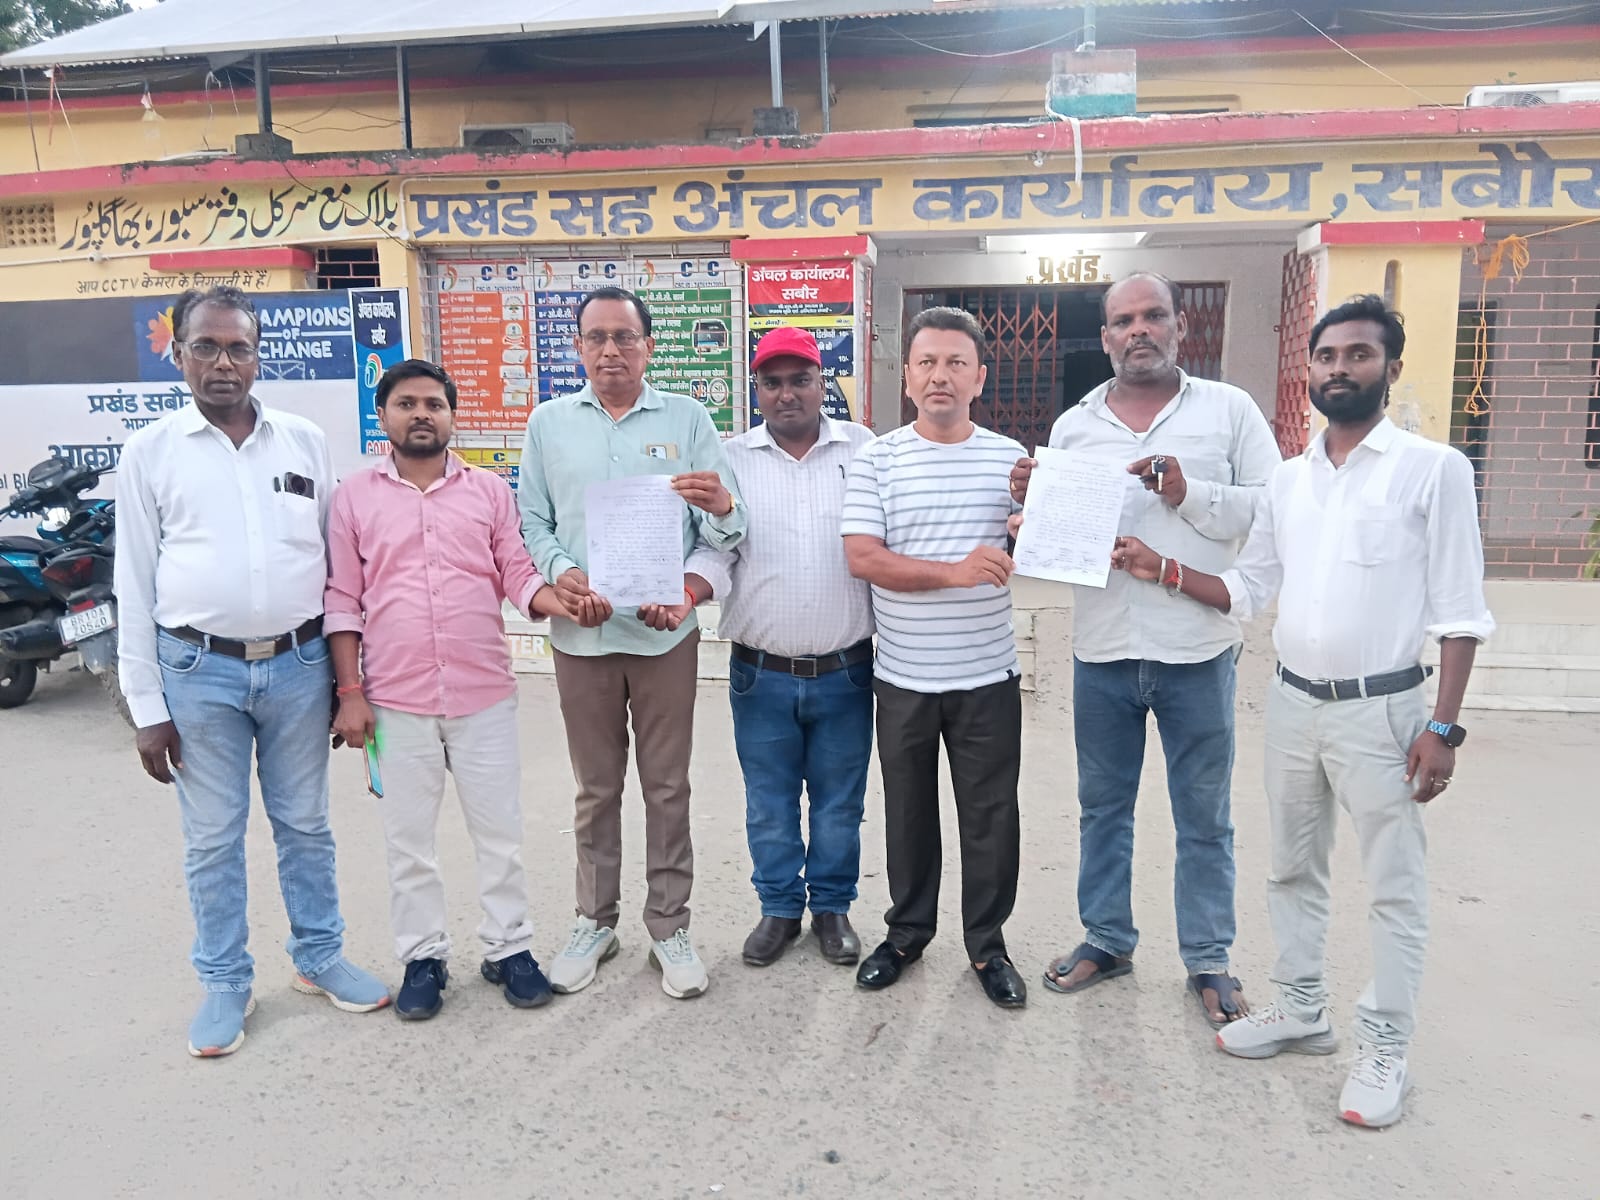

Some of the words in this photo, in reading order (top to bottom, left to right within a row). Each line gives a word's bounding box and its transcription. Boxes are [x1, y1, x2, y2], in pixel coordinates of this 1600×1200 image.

[409, 179, 538, 239] प्रखंड
[548, 186, 658, 237] सह
[673, 169, 883, 233] अंचल
[76, 280, 98, 294] आप
[178, 272, 190, 289] के
[751, 266, 788, 282] अंचल
[790, 264, 850, 281] कार्यालय,
[781, 284, 819, 300] सबौर
[260, 306, 351, 327] AMPIONS
[282, 328, 300, 340] OF
[258, 341, 332, 358] CHANGE
[87, 388, 138, 413] प्रखंड
[508, 635, 546, 656] TER
